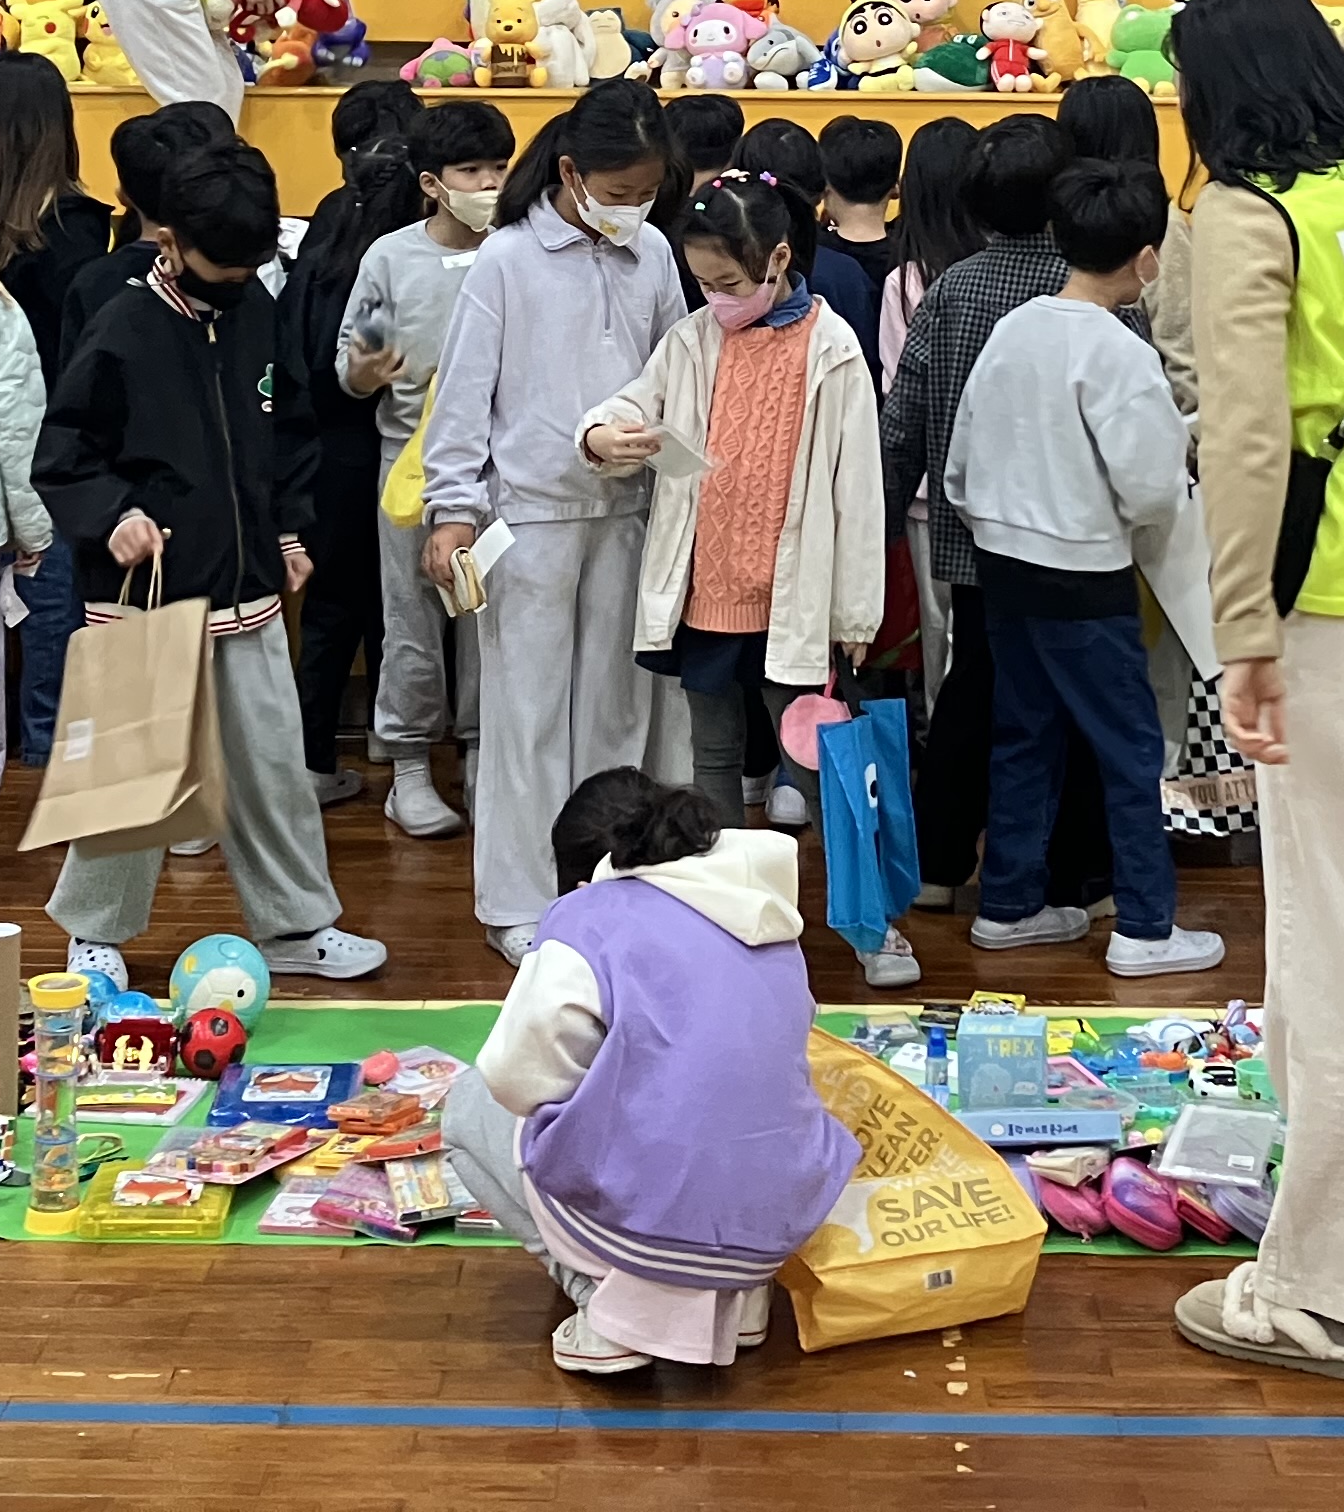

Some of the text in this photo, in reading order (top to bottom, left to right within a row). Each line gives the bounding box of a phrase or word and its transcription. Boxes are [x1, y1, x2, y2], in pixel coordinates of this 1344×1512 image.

[856, 1111, 919, 1179] LEAN
[894, 1127, 944, 1175] TER.
[876, 1178, 1001, 1224] SAVE
[880, 1204, 1016, 1247] OUR LIFE!
